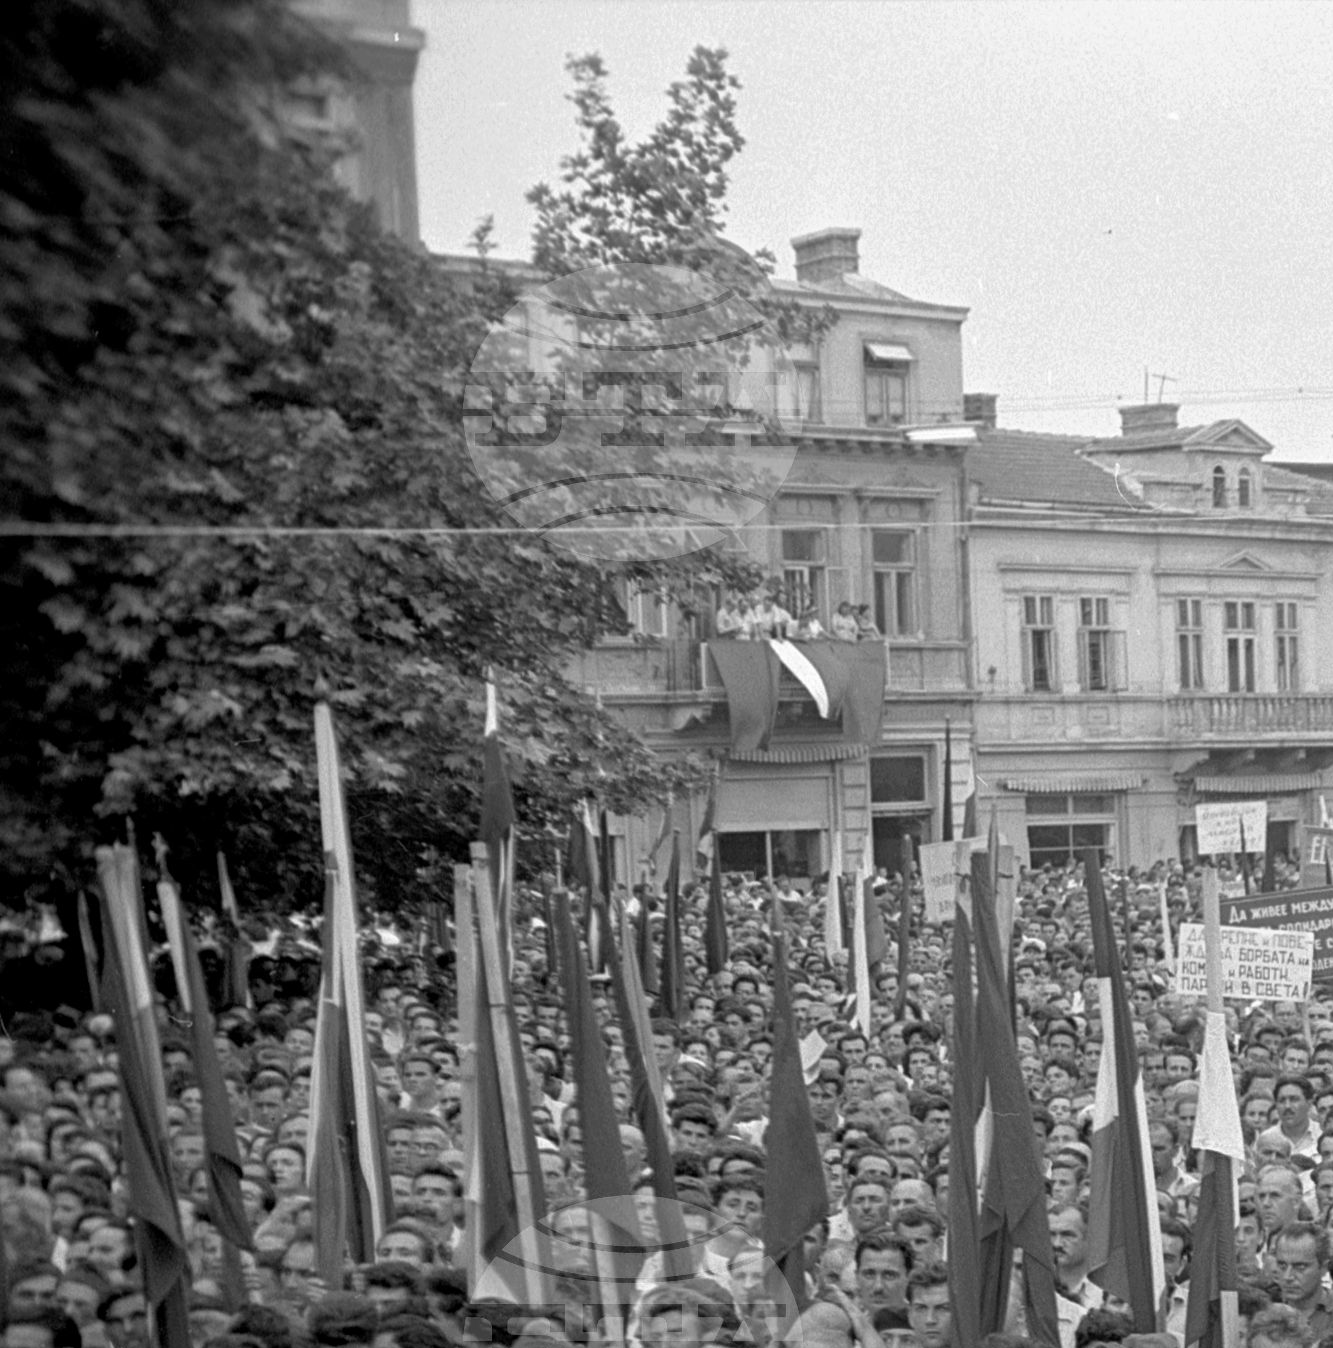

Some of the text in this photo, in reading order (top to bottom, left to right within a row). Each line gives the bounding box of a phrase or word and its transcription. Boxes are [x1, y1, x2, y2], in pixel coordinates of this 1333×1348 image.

[1250, 904, 1287, 920] ЖИВЕЕ
[1239, 947, 1295, 965] БОРБАТА
[1241, 981, 1250, 996] В
